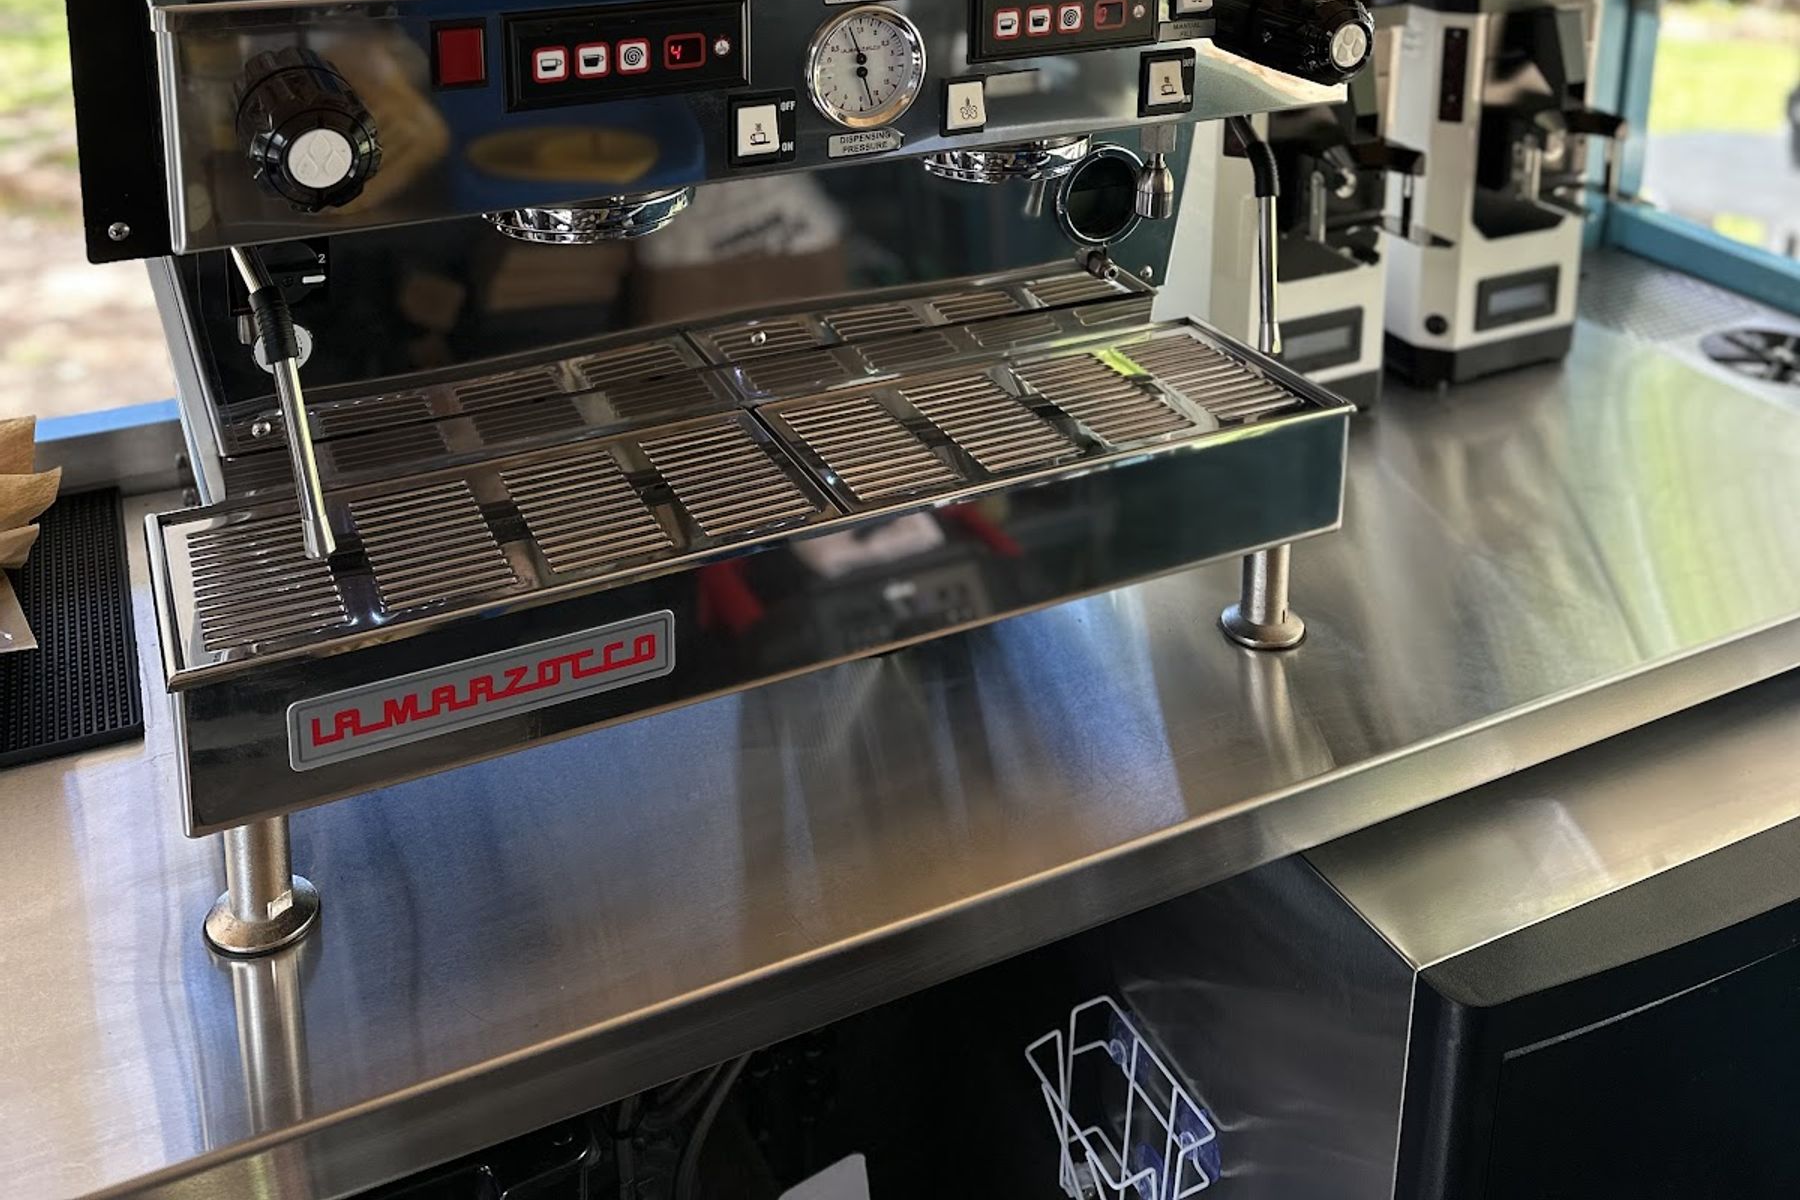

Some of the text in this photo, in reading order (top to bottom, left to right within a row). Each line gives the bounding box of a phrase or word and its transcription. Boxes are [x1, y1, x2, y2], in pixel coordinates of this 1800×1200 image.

[780, 101, 796, 112] OFF
[840, 130, 891, 144] DISPENSING
[781, 141, 794, 152] ON
[842, 140, 888, 153] PRESSURE
[317, 253, 327, 264] 2
[312, 633, 657, 747] LA MARZOCCO
